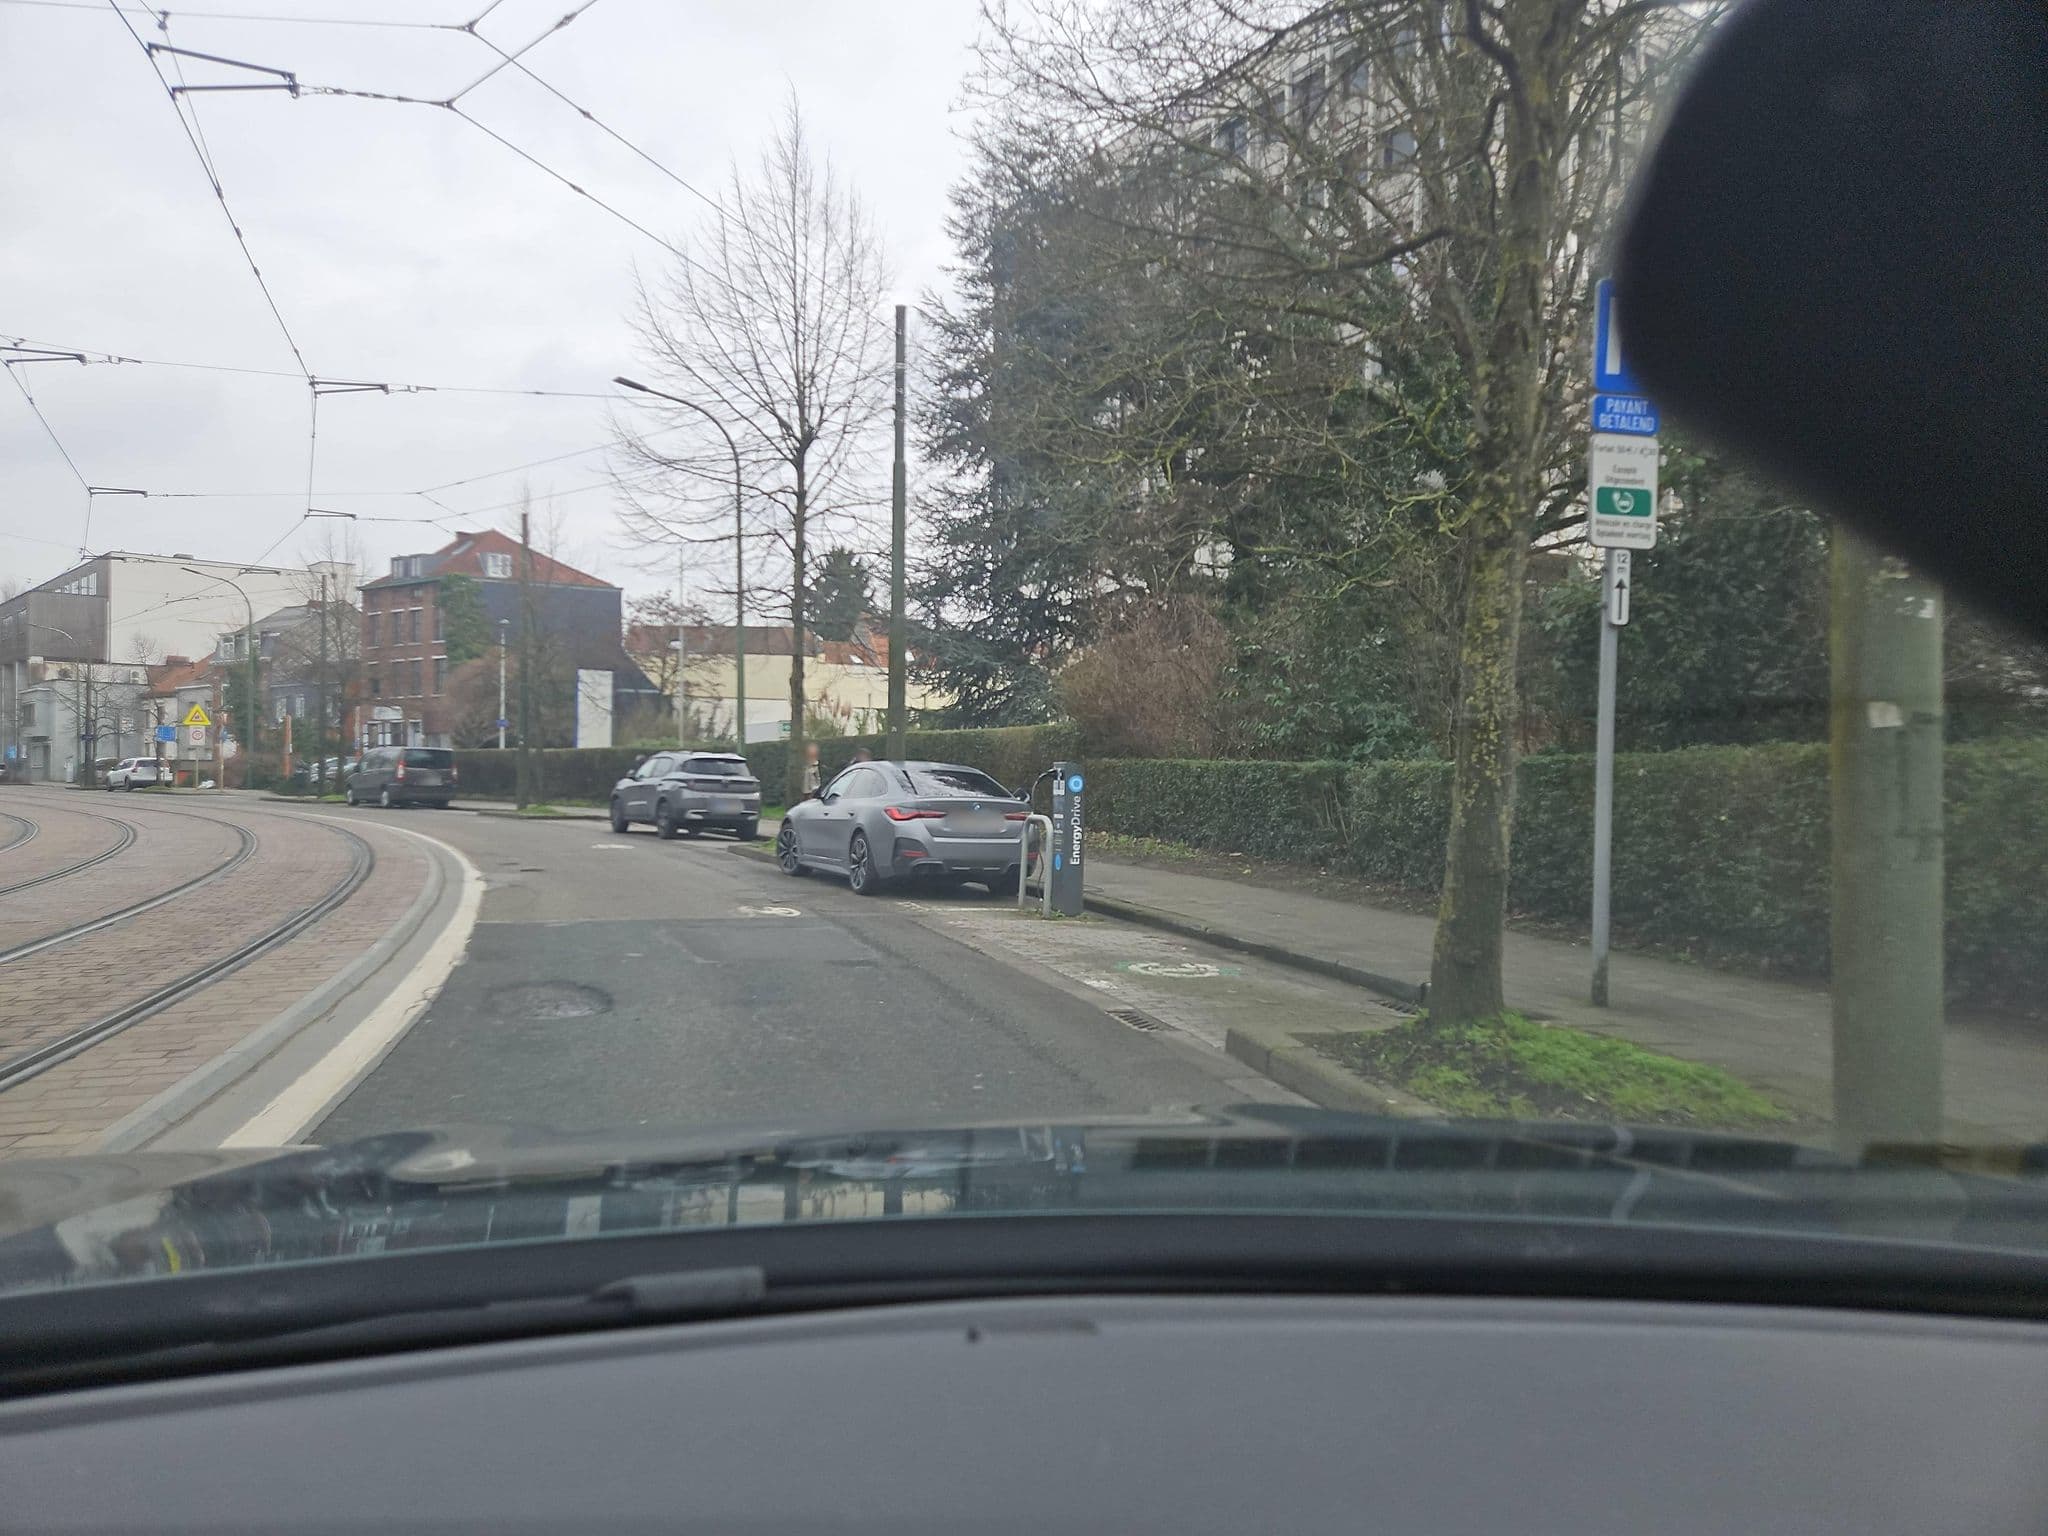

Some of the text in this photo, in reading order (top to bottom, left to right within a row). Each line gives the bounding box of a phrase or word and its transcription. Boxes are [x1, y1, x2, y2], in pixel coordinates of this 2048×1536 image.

[1606, 398, 1649, 415] PAYANT
[1599, 413, 1655, 432] BETALEND
[1617, 553, 1628, 564] 12
[1070, 796, 1083, 864] EnergyDrive
